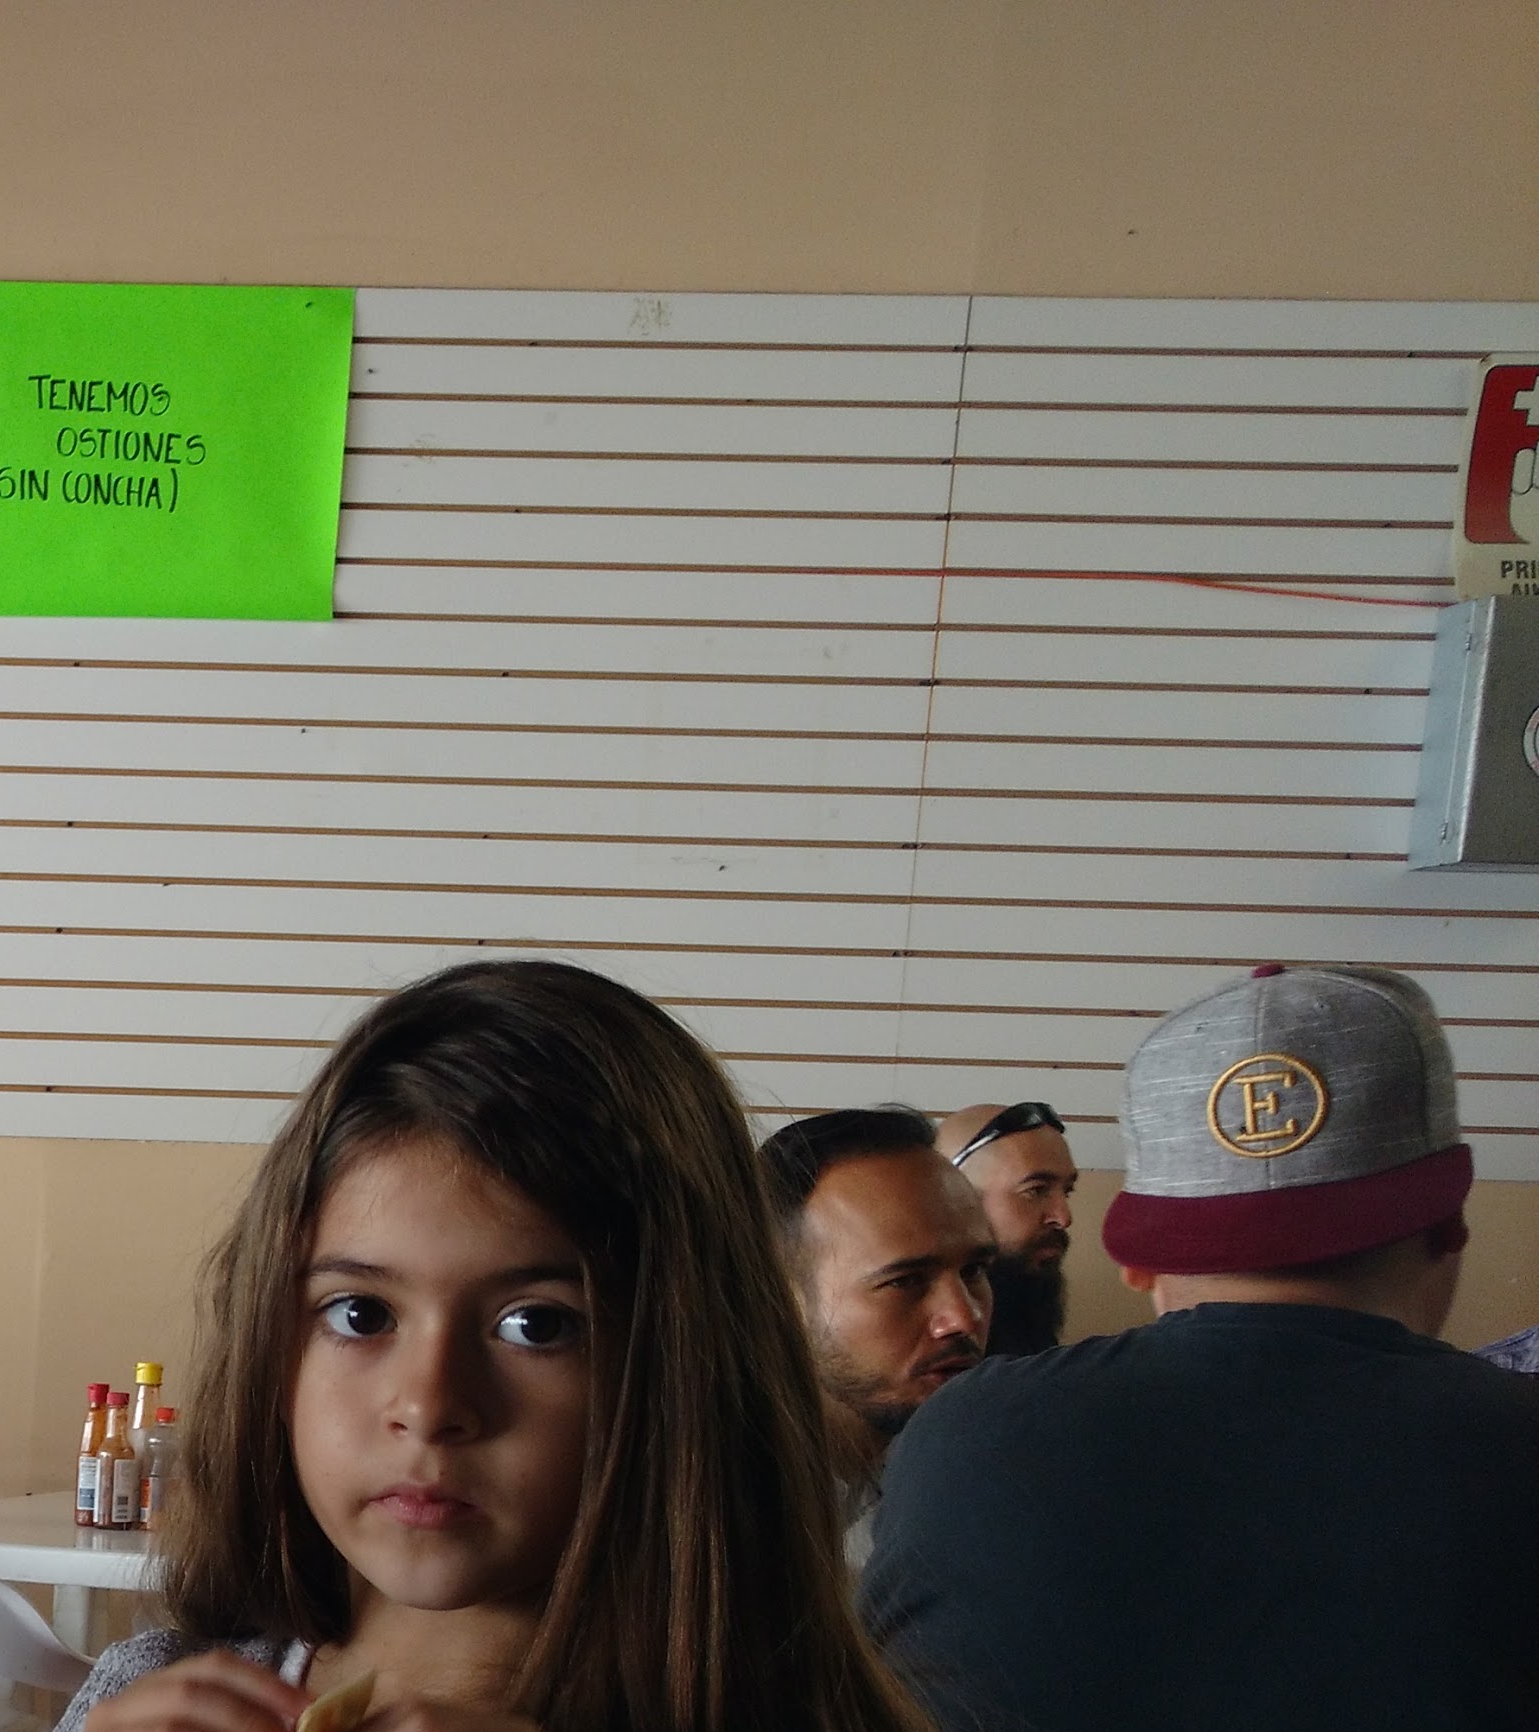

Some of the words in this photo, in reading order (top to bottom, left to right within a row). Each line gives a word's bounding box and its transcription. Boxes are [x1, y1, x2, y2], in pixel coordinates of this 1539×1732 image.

[28, 374, 172, 416] TENEMOS
[56, 427, 207, 466] OSTIONES
[62, 468, 180, 513] CONCHA)
[1501, 560, 1539, 579] PRI
[1232, 1070, 1298, 1142] E
